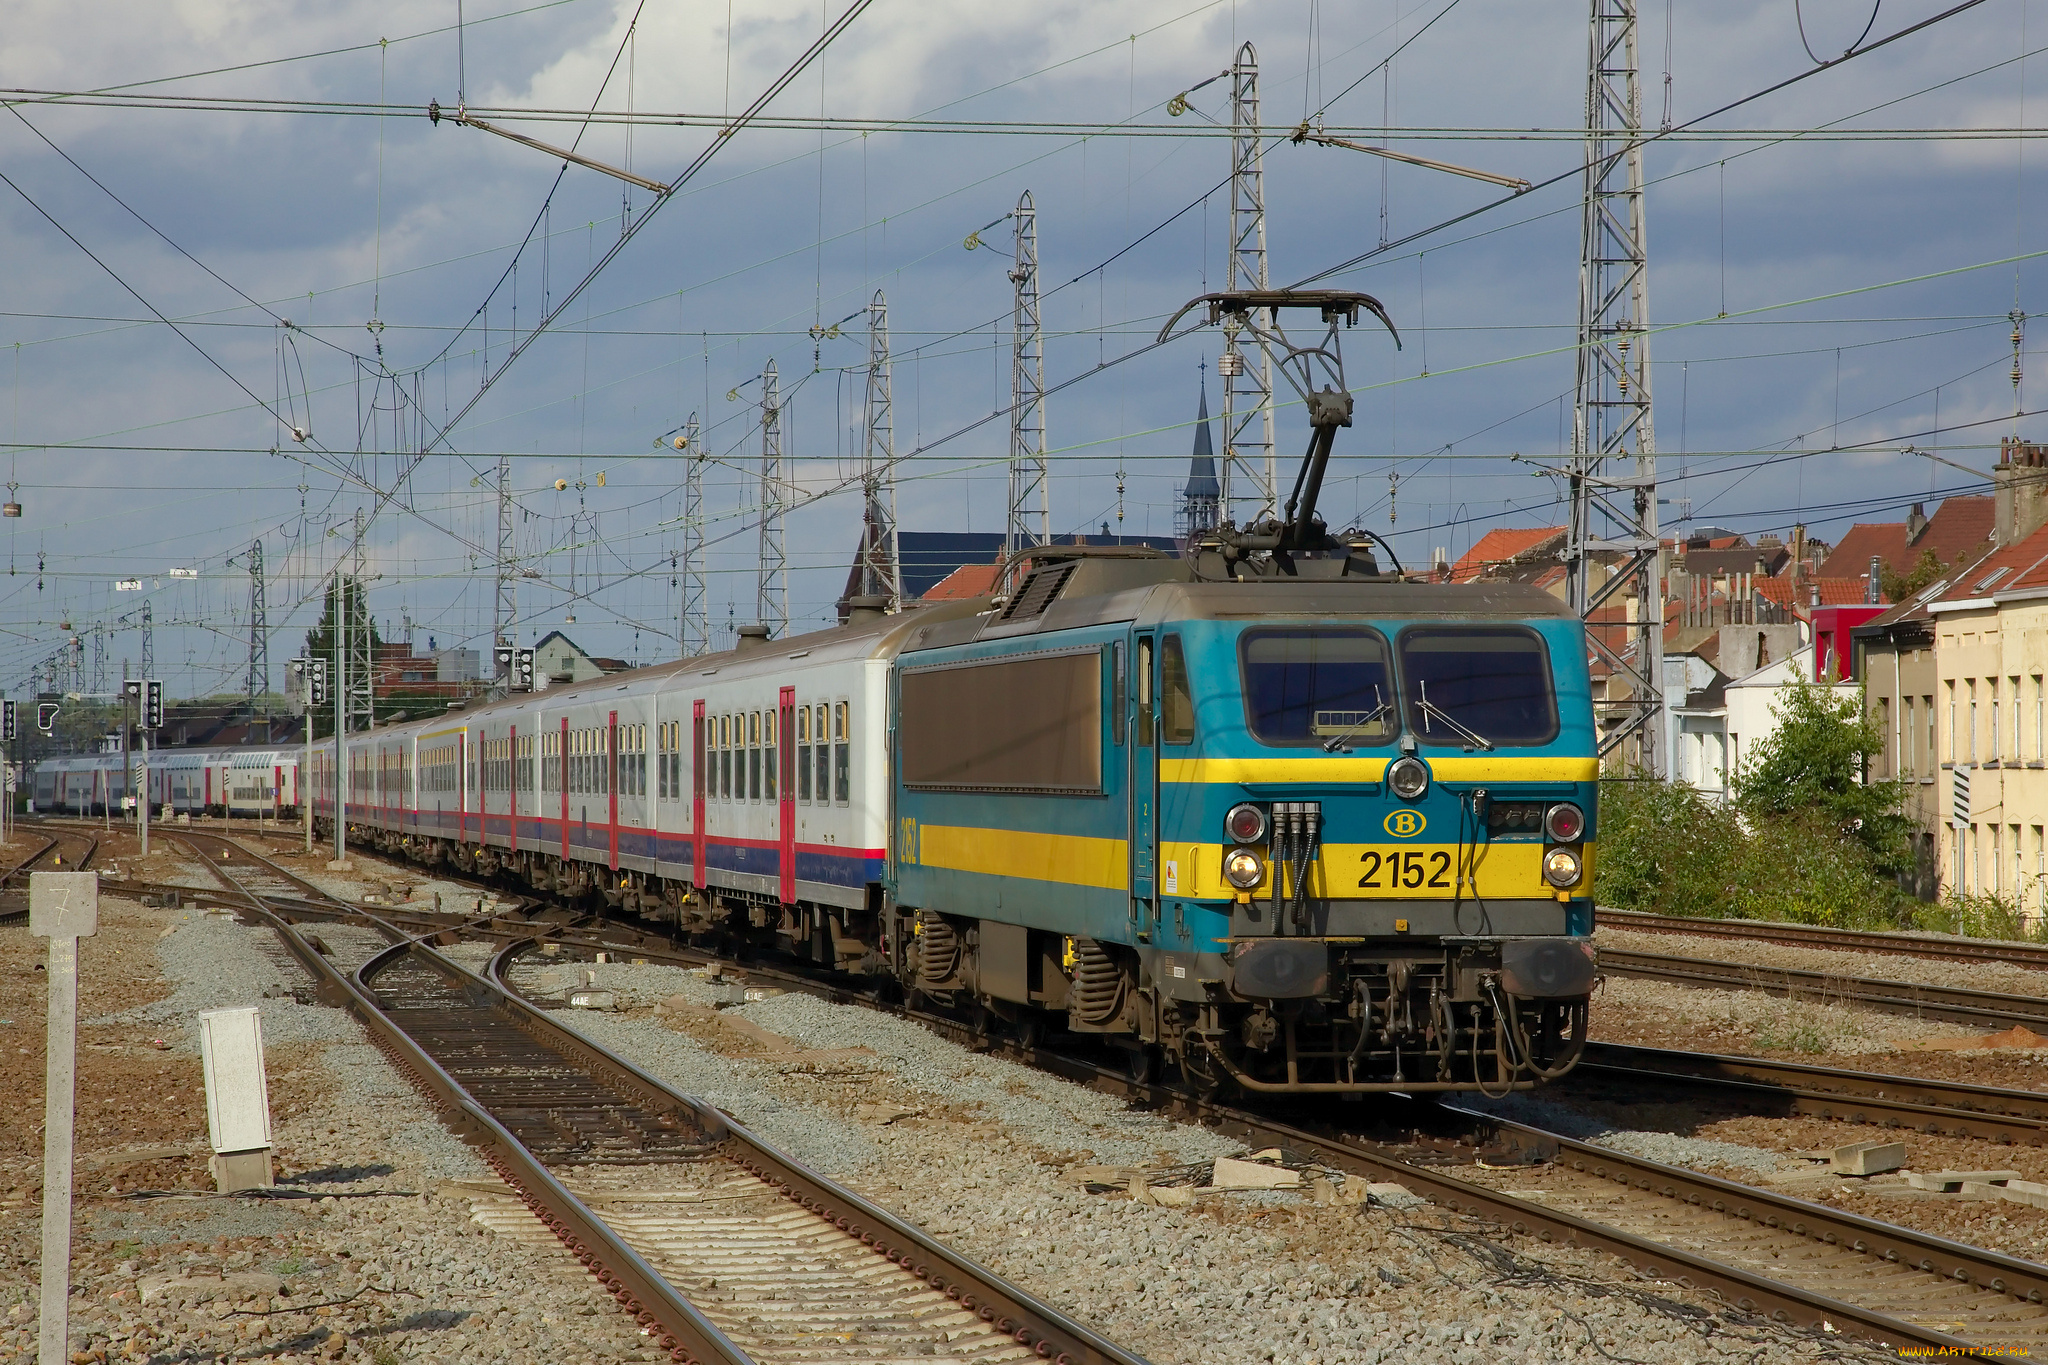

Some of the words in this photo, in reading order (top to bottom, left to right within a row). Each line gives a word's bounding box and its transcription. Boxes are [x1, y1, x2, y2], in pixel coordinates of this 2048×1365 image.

[1144, 803, 1148, 816] 2
[901, 816, 916, 864] 2152
[1358, 851, 1451, 888] 2152
[49, 888, 71, 926] 7
